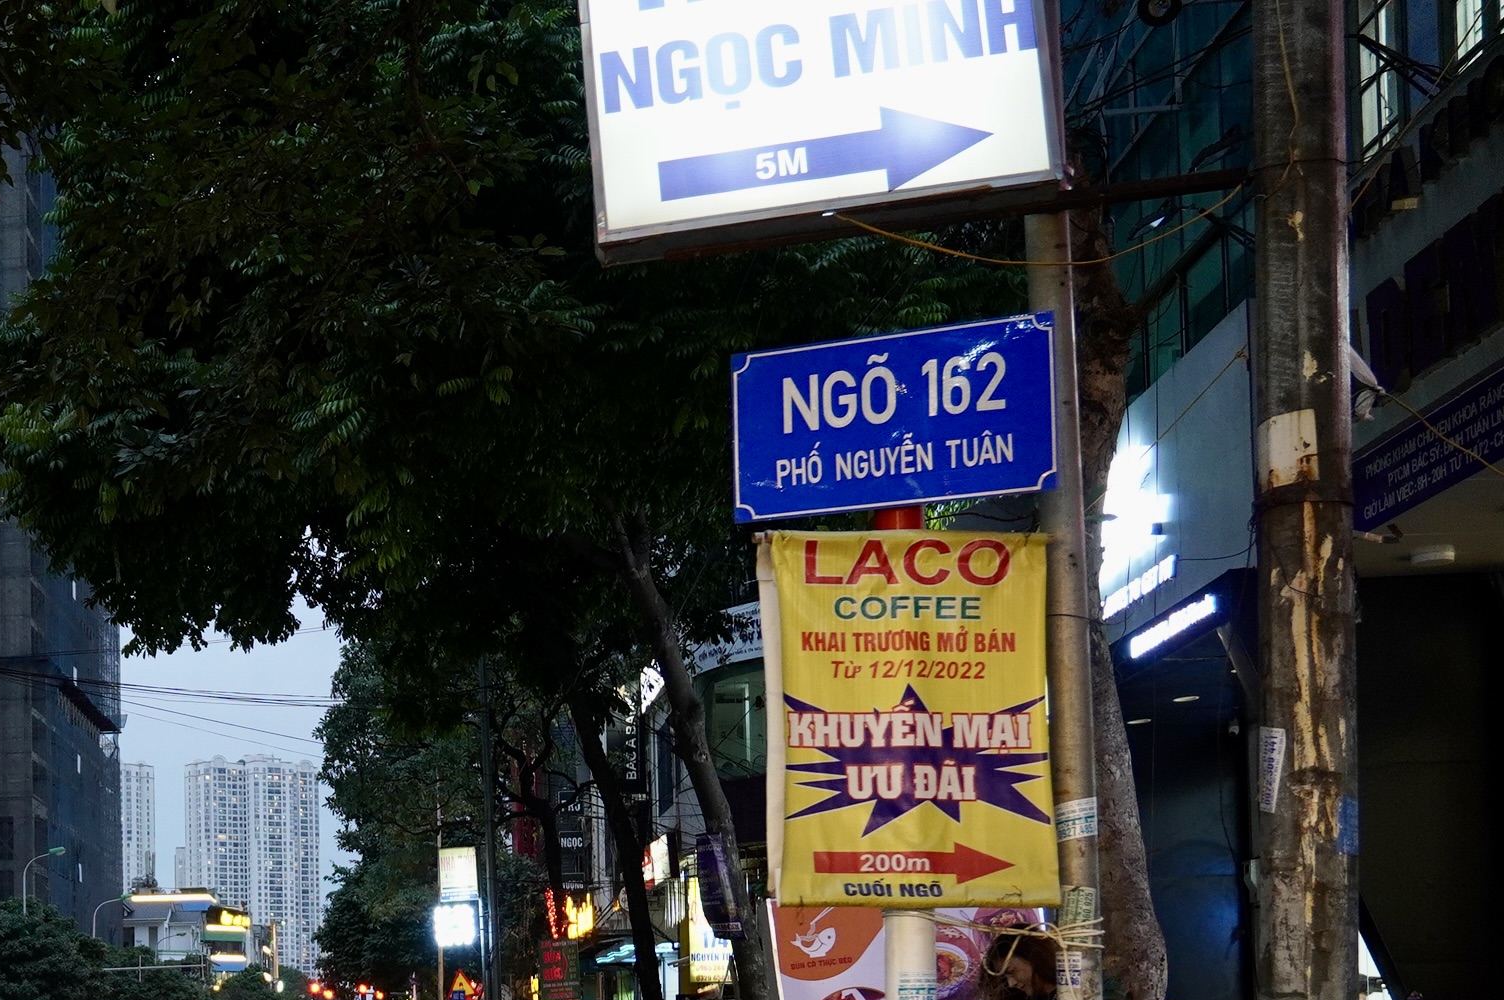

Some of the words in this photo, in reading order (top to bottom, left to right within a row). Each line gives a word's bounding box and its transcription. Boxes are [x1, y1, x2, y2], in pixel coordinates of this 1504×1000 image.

[599, 23, 802, 114] NGỌC
[828, 0, 1037, 79] MINH
[755, 147, 808, 180] 5M
[782, 353, 896, 435] NGÕ
[922, 351, 1007, 417] 162
[776, 447, 823, 488] PHỐ
[836, 432, 933, 483] NGUYỄN
[947, 432, 1014, 470] TUÂN
[804, 538, 1012, 586] LACO
[833, 595, 982, 620] COFFEE
[801, 631, 846, 652] KHAI
[852, 630, 931, 652] TRƯƠNG
[937, 625, 969, 653] MỞ
[974, 628, 1016, 653] BÁN
[831, 661, 862, 679] Từ
[869, 659, 986, 679] 12/12/2022
[787, 699, 943, 748] KHUYẾN
[952, 711, 1032, 755] MẠI
[846, 763, 903, 801] ƯU
[913, 759, 976, 801] ĐÃI
[561, 837, 583, 849] NGỌC
[859, 854, 930, 872] 200m
[844, 878, 892, 897] CUỐI
[899, 880, 943, 898] NGÕ
